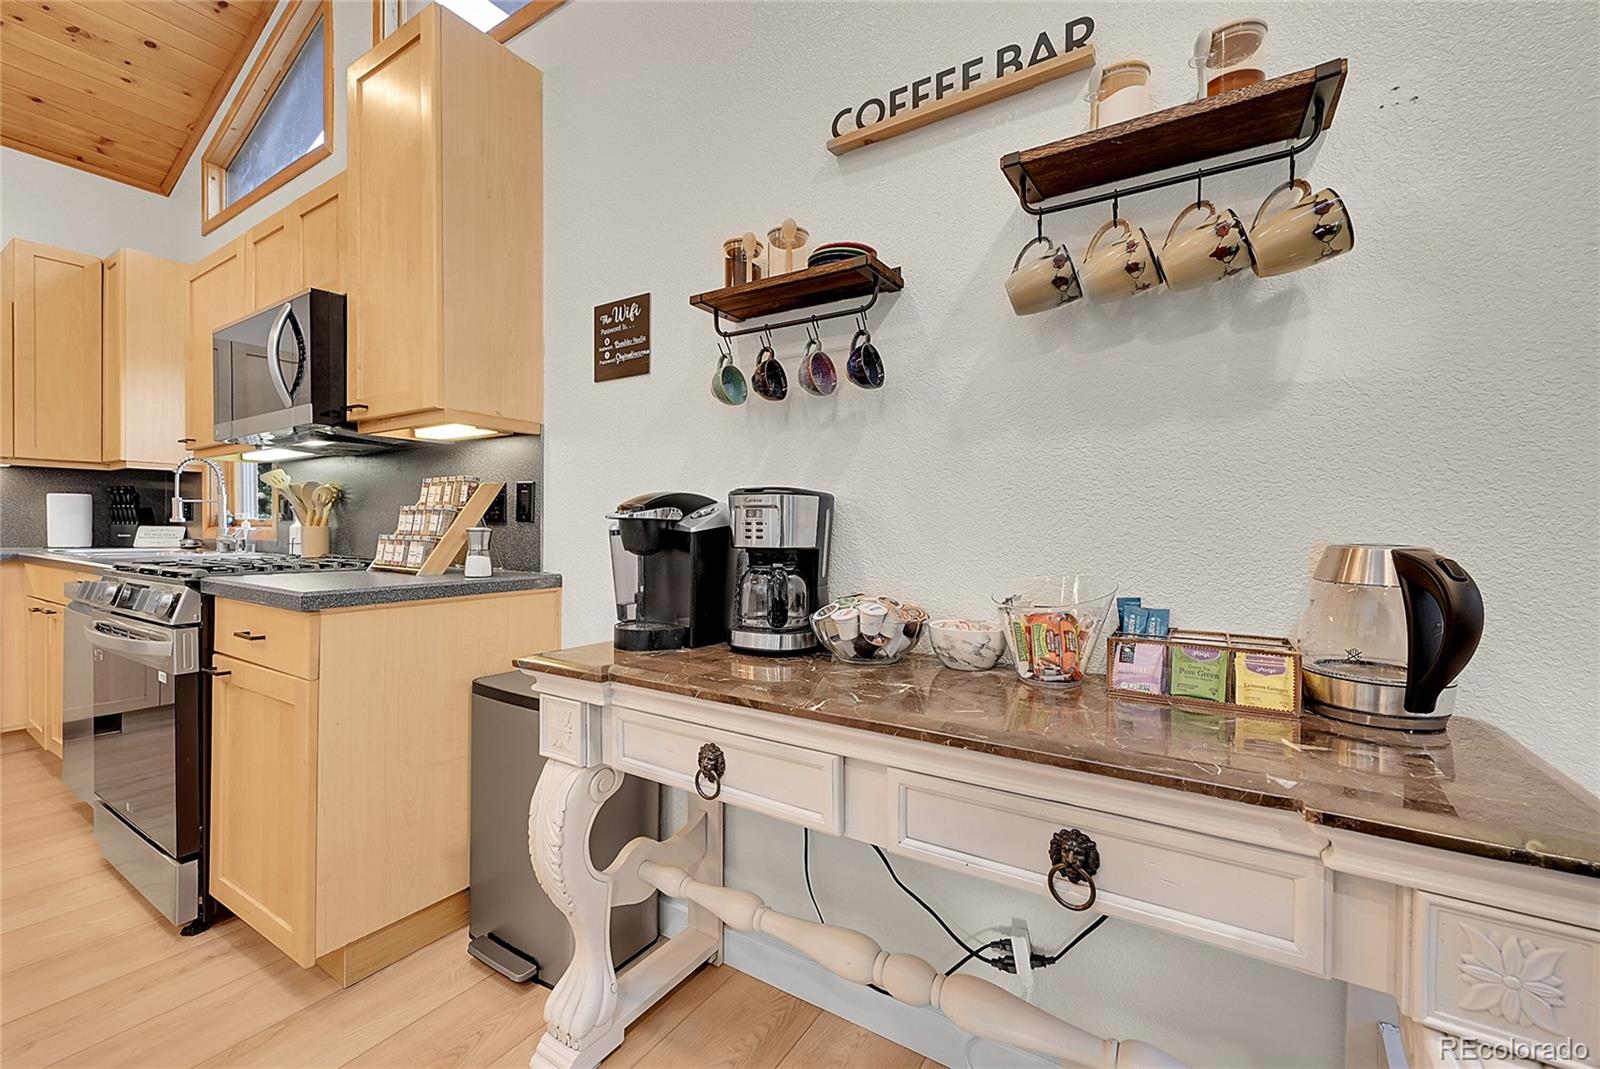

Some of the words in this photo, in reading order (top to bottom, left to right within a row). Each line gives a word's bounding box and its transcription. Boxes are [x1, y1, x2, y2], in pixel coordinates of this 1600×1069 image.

[831, 56, 984, 138] COFFEE
[996, 16, 1096, 78] BAR
[612, 302, 642, 323] Wifi
[1179, 667, 1196, 676] Pure
[1197, 670, 1220, 680] Green
